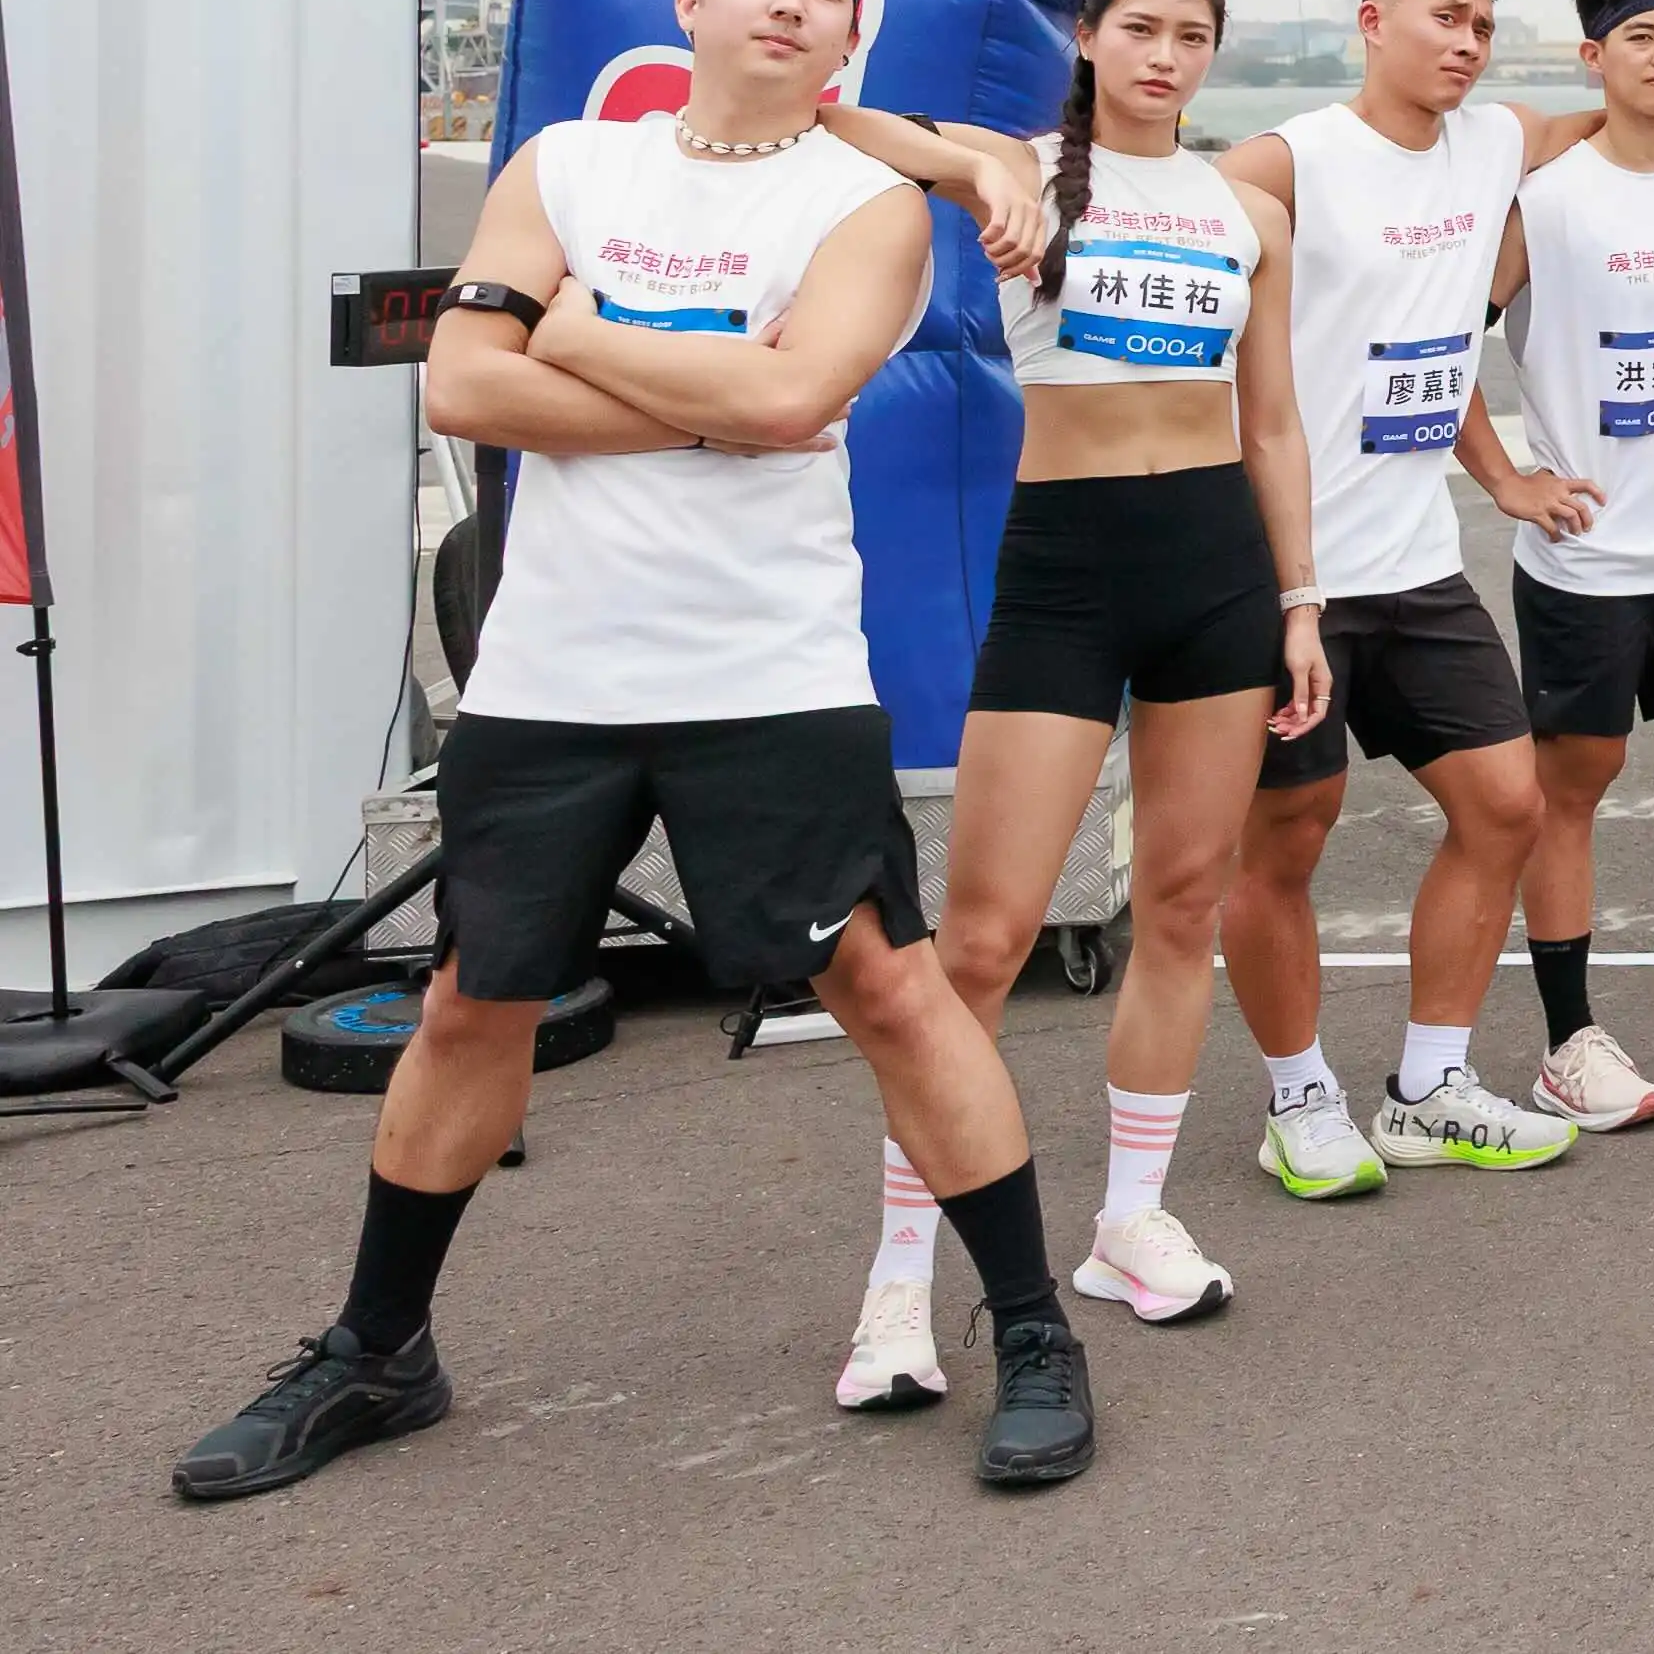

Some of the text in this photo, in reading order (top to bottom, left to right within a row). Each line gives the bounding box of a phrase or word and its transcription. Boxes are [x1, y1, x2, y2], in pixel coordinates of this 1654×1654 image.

[1090, 268, 1222, 315] 林佳祐
[1626, 273, 1650, 286] THE
[1083, 332, 1205, 358] GAME 0004
[1414, 422, 1456, 443] 000
[1387, 1107, 1517, 1155] HYROX
